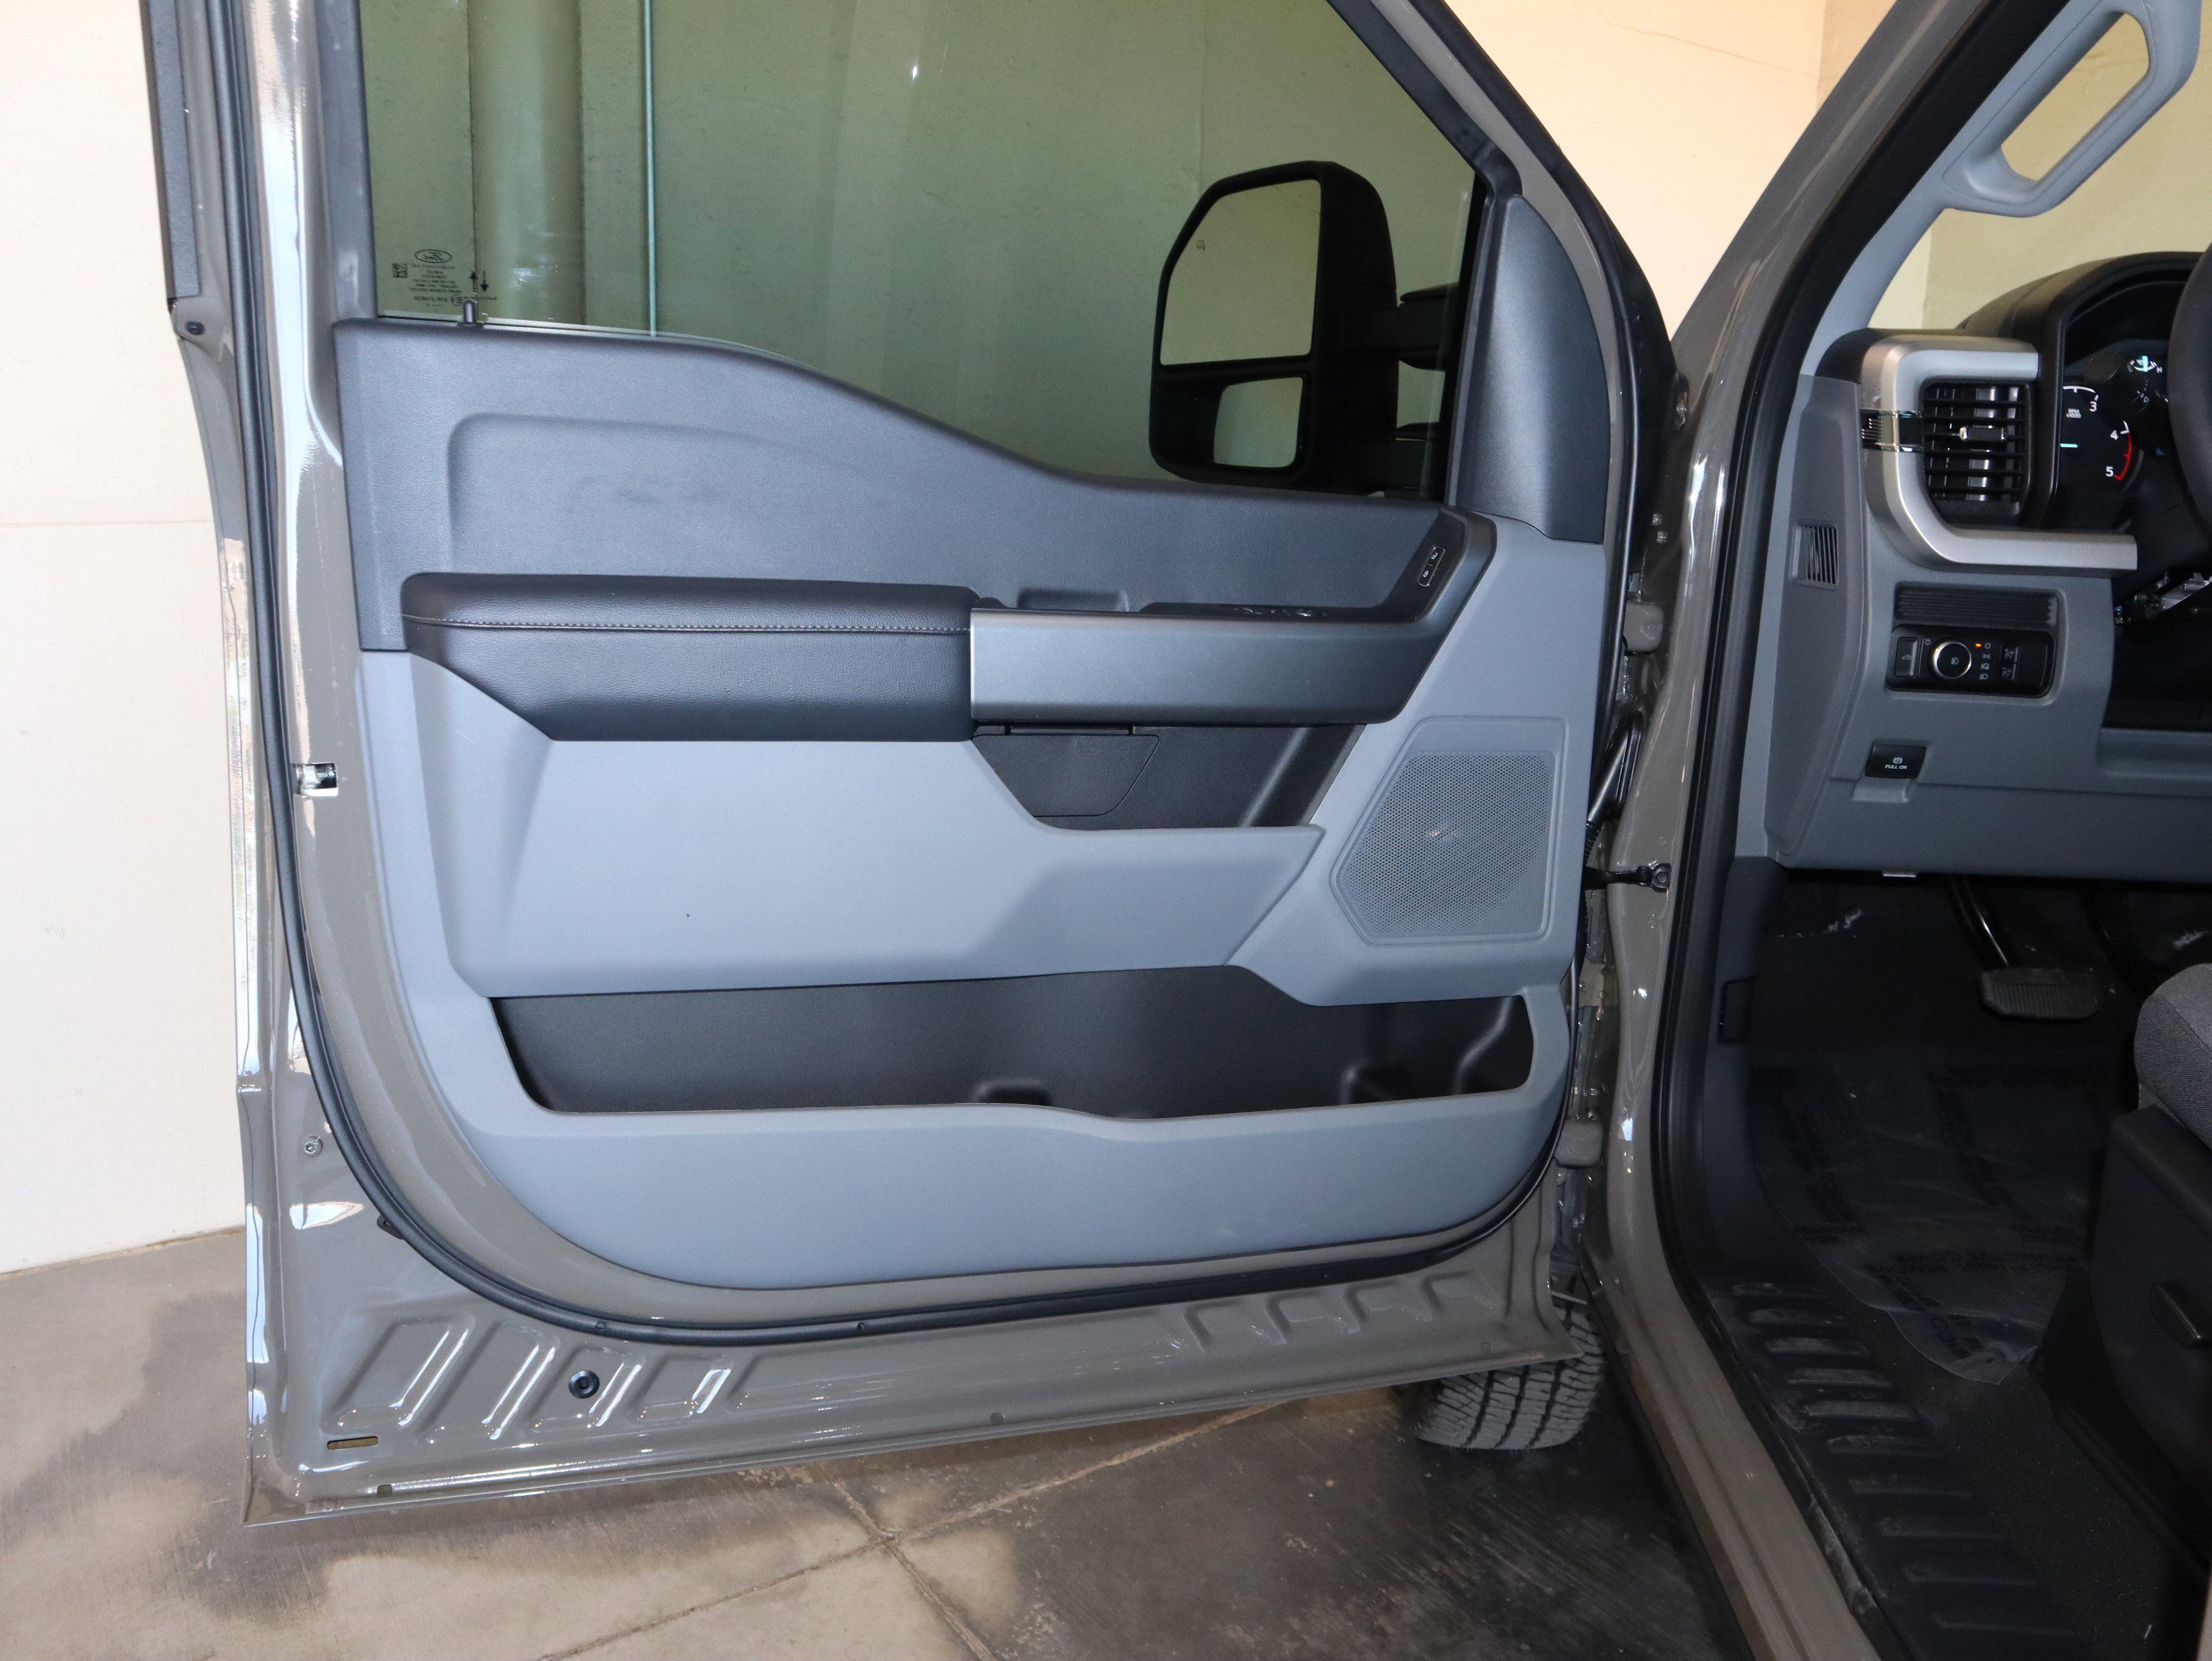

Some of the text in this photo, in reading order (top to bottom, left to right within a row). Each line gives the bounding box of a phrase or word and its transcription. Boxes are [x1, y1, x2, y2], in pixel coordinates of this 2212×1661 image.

[2089, 401, 2097, 412] 3
[2110, 430, 2119, 440] 4
[2106, 466, 2114, 477] 5
